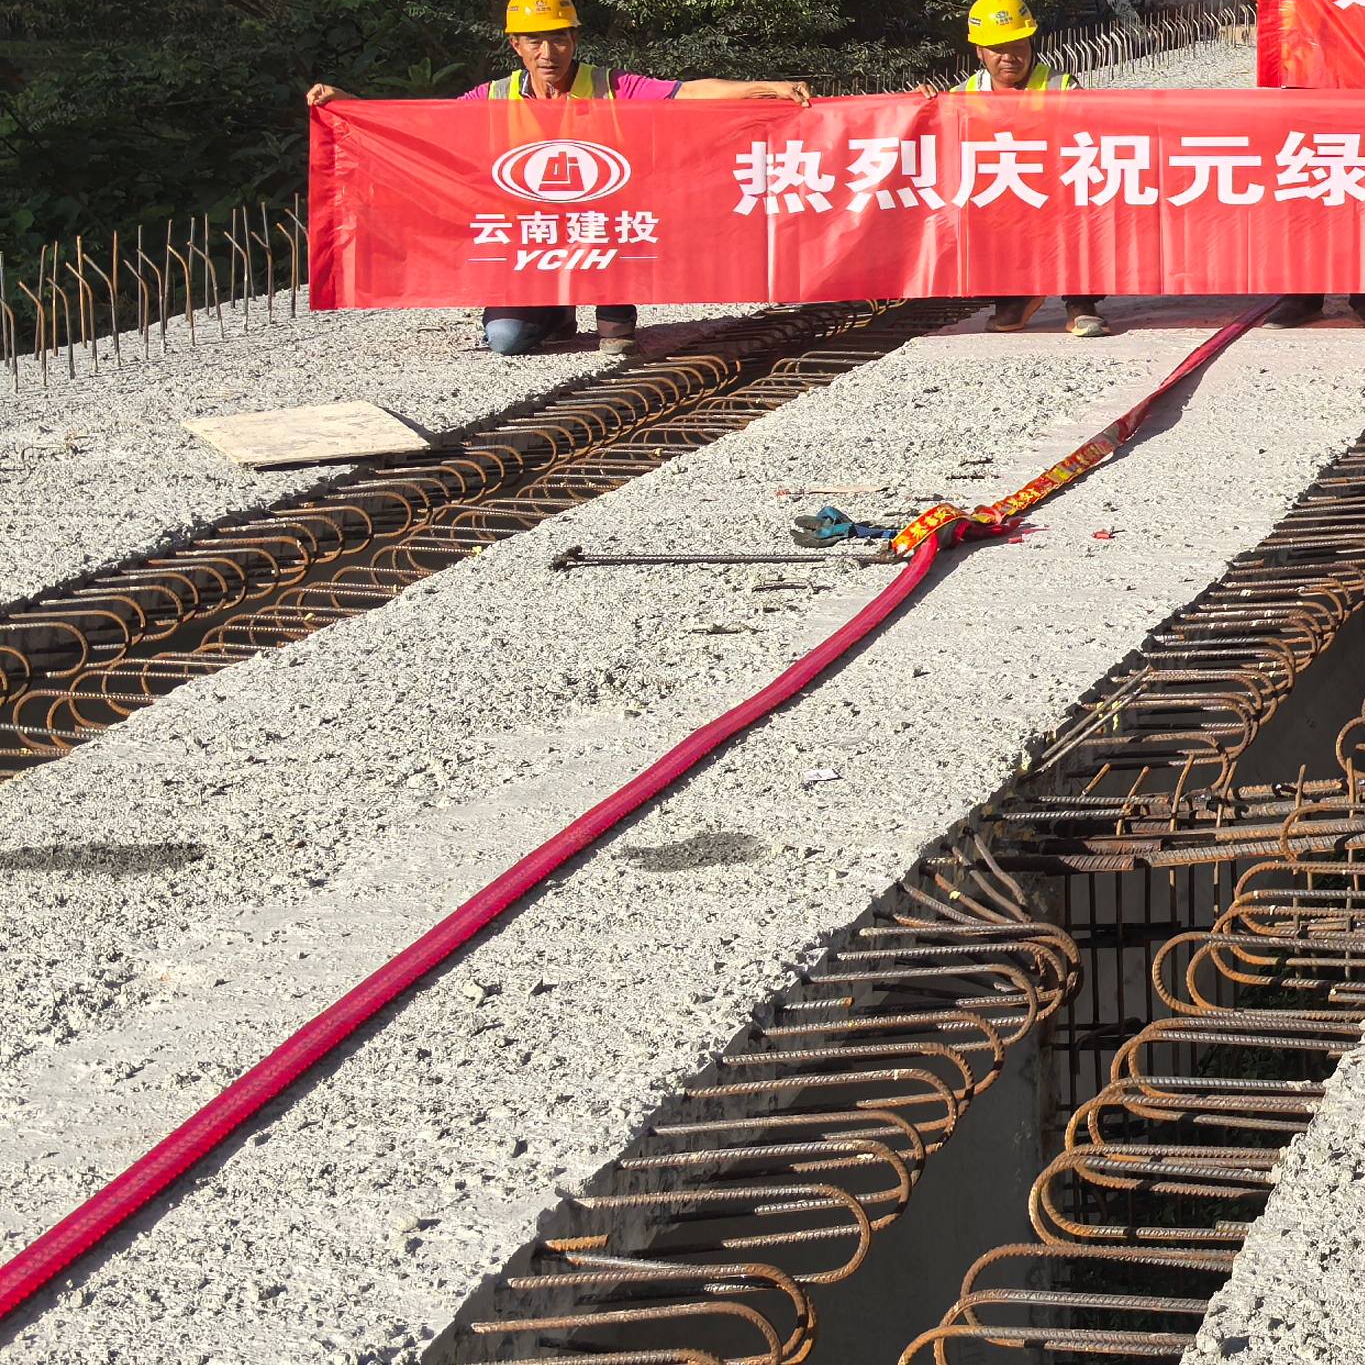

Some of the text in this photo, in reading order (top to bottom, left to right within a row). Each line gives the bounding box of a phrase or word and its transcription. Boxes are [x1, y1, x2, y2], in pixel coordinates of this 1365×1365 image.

[469, 210, 660, 245] 云南建投
[513, 248, 618, 271] YCIH
